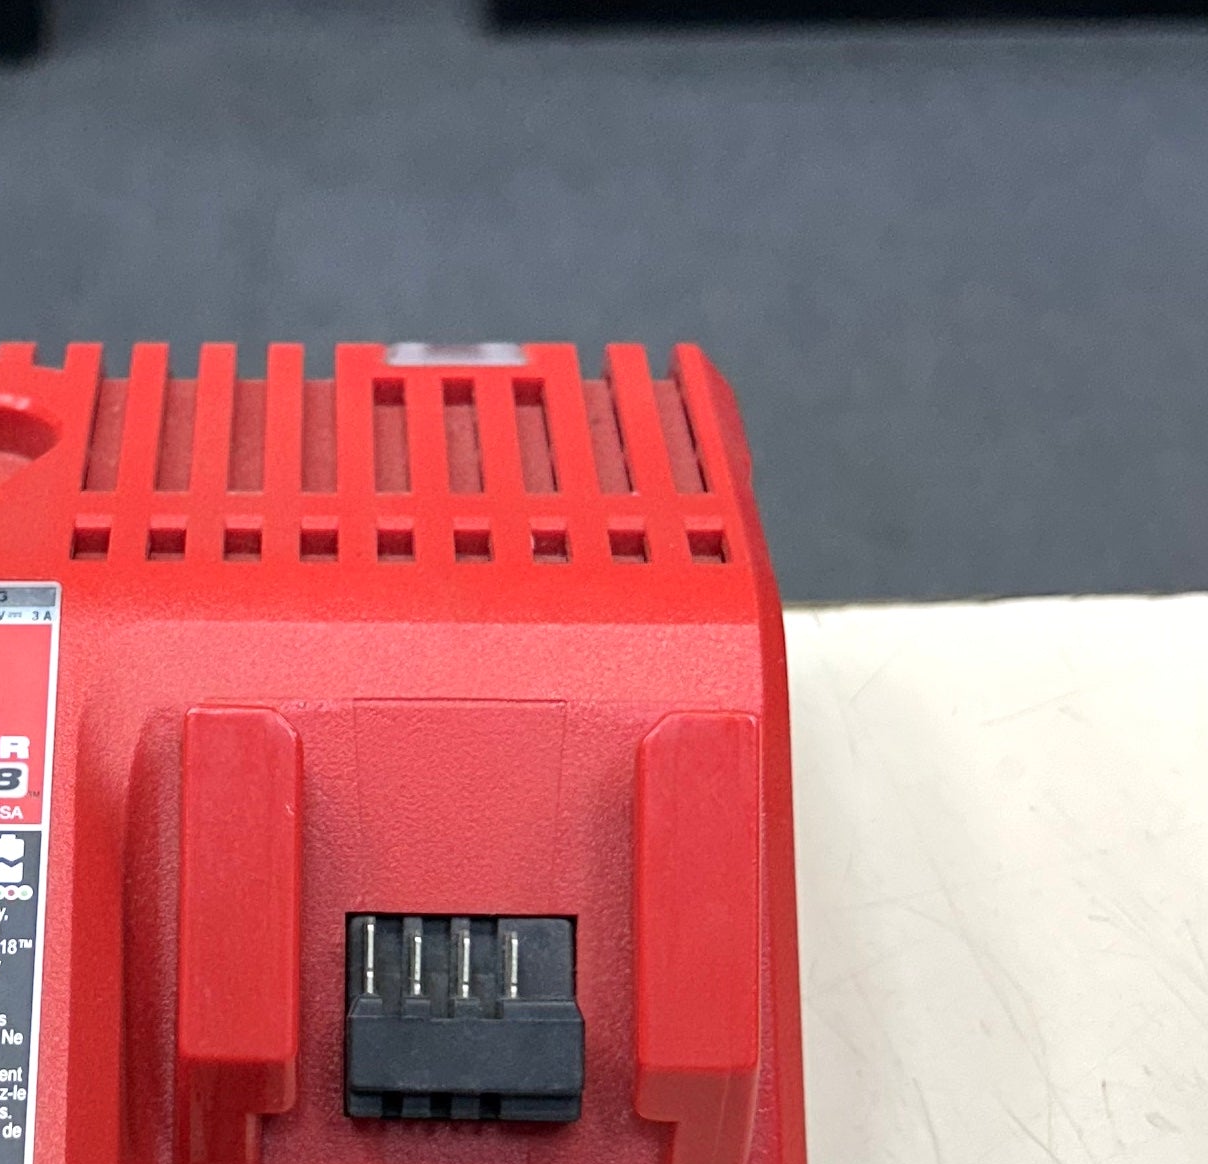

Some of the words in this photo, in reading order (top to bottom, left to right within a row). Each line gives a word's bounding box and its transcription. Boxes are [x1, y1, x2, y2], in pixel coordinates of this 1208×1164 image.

[32, 612, 39, 620] 3
[44, 612, 52, 621] A
[2, 1030, 23, 1045] Ne
[2, 1124, 22, 1138] de
